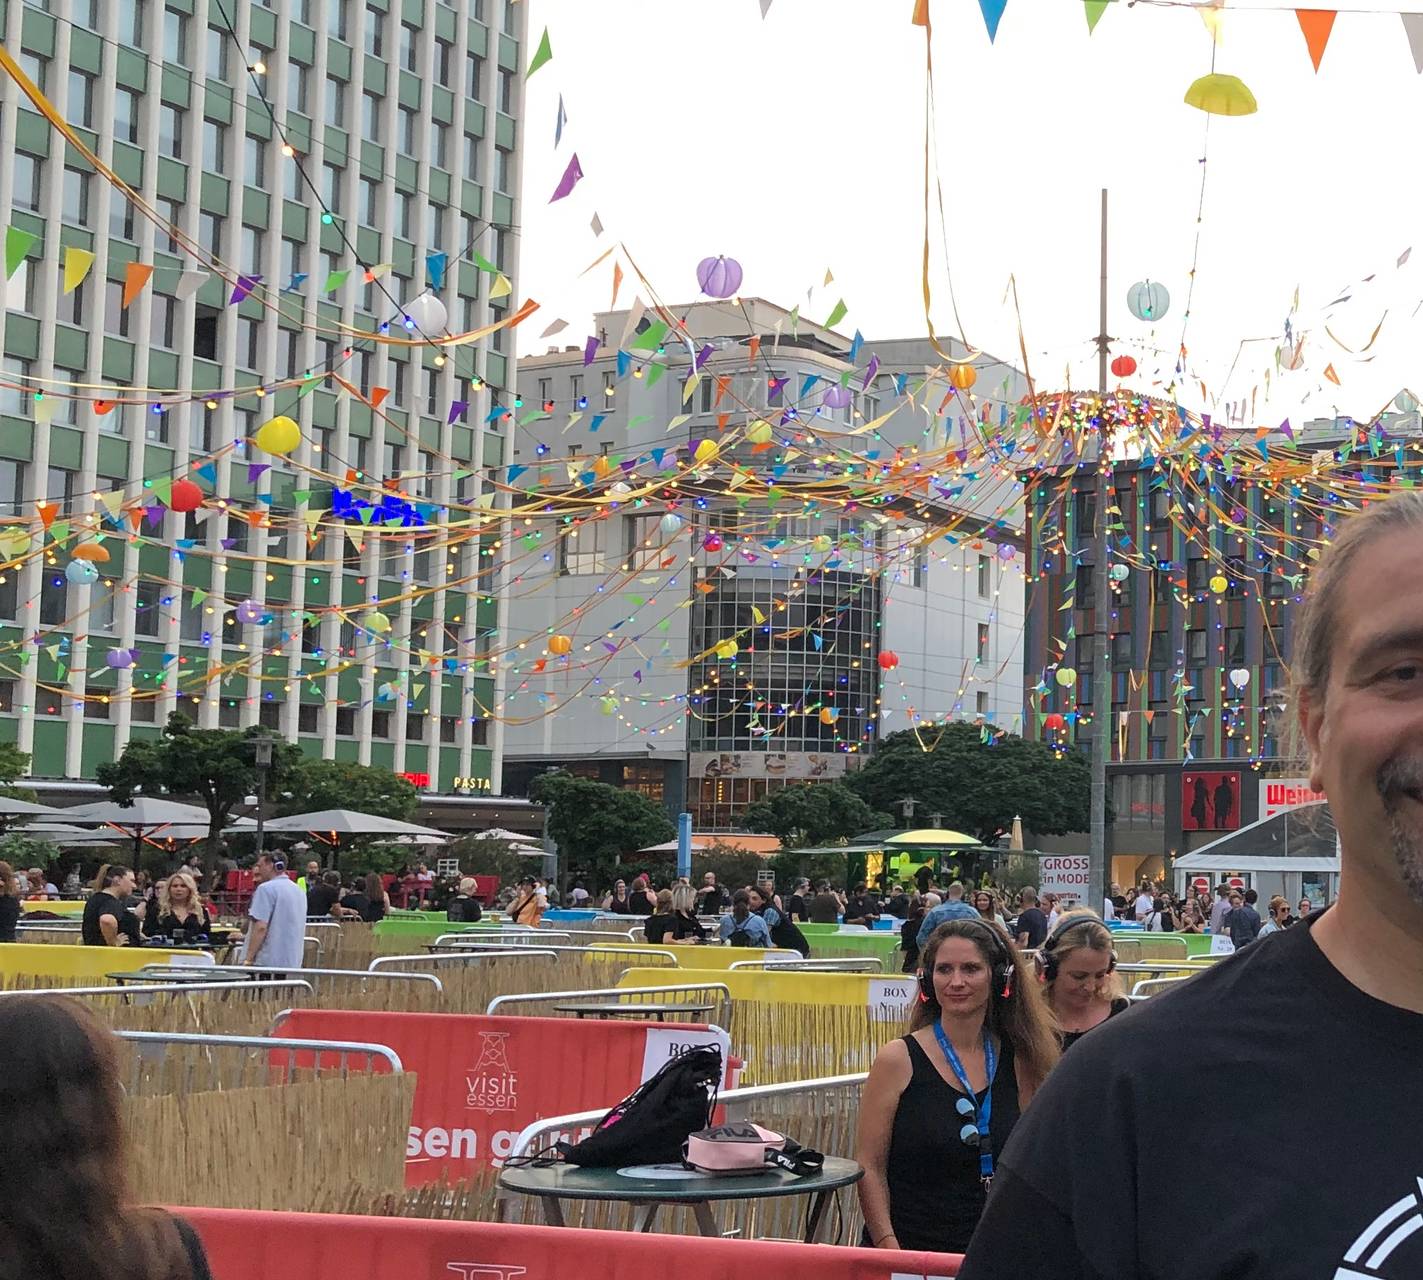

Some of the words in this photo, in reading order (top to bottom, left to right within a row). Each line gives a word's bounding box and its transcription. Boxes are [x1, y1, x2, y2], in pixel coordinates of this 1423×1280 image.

[454, 776, 491, 789] PASTA
[1043, 858, 1089, 870] GROSS
[1043, 872, 1054, 884] in
[1056, 873, 1089, 884] MODE
[883, 987, 907, 998] BOX
[668, 1042, 697, 1057] BO
[466, 1071, 518, 1095] visit
[466, 1093, 518, 1107] essen
[776, 1154, 796, 1170] FILA
